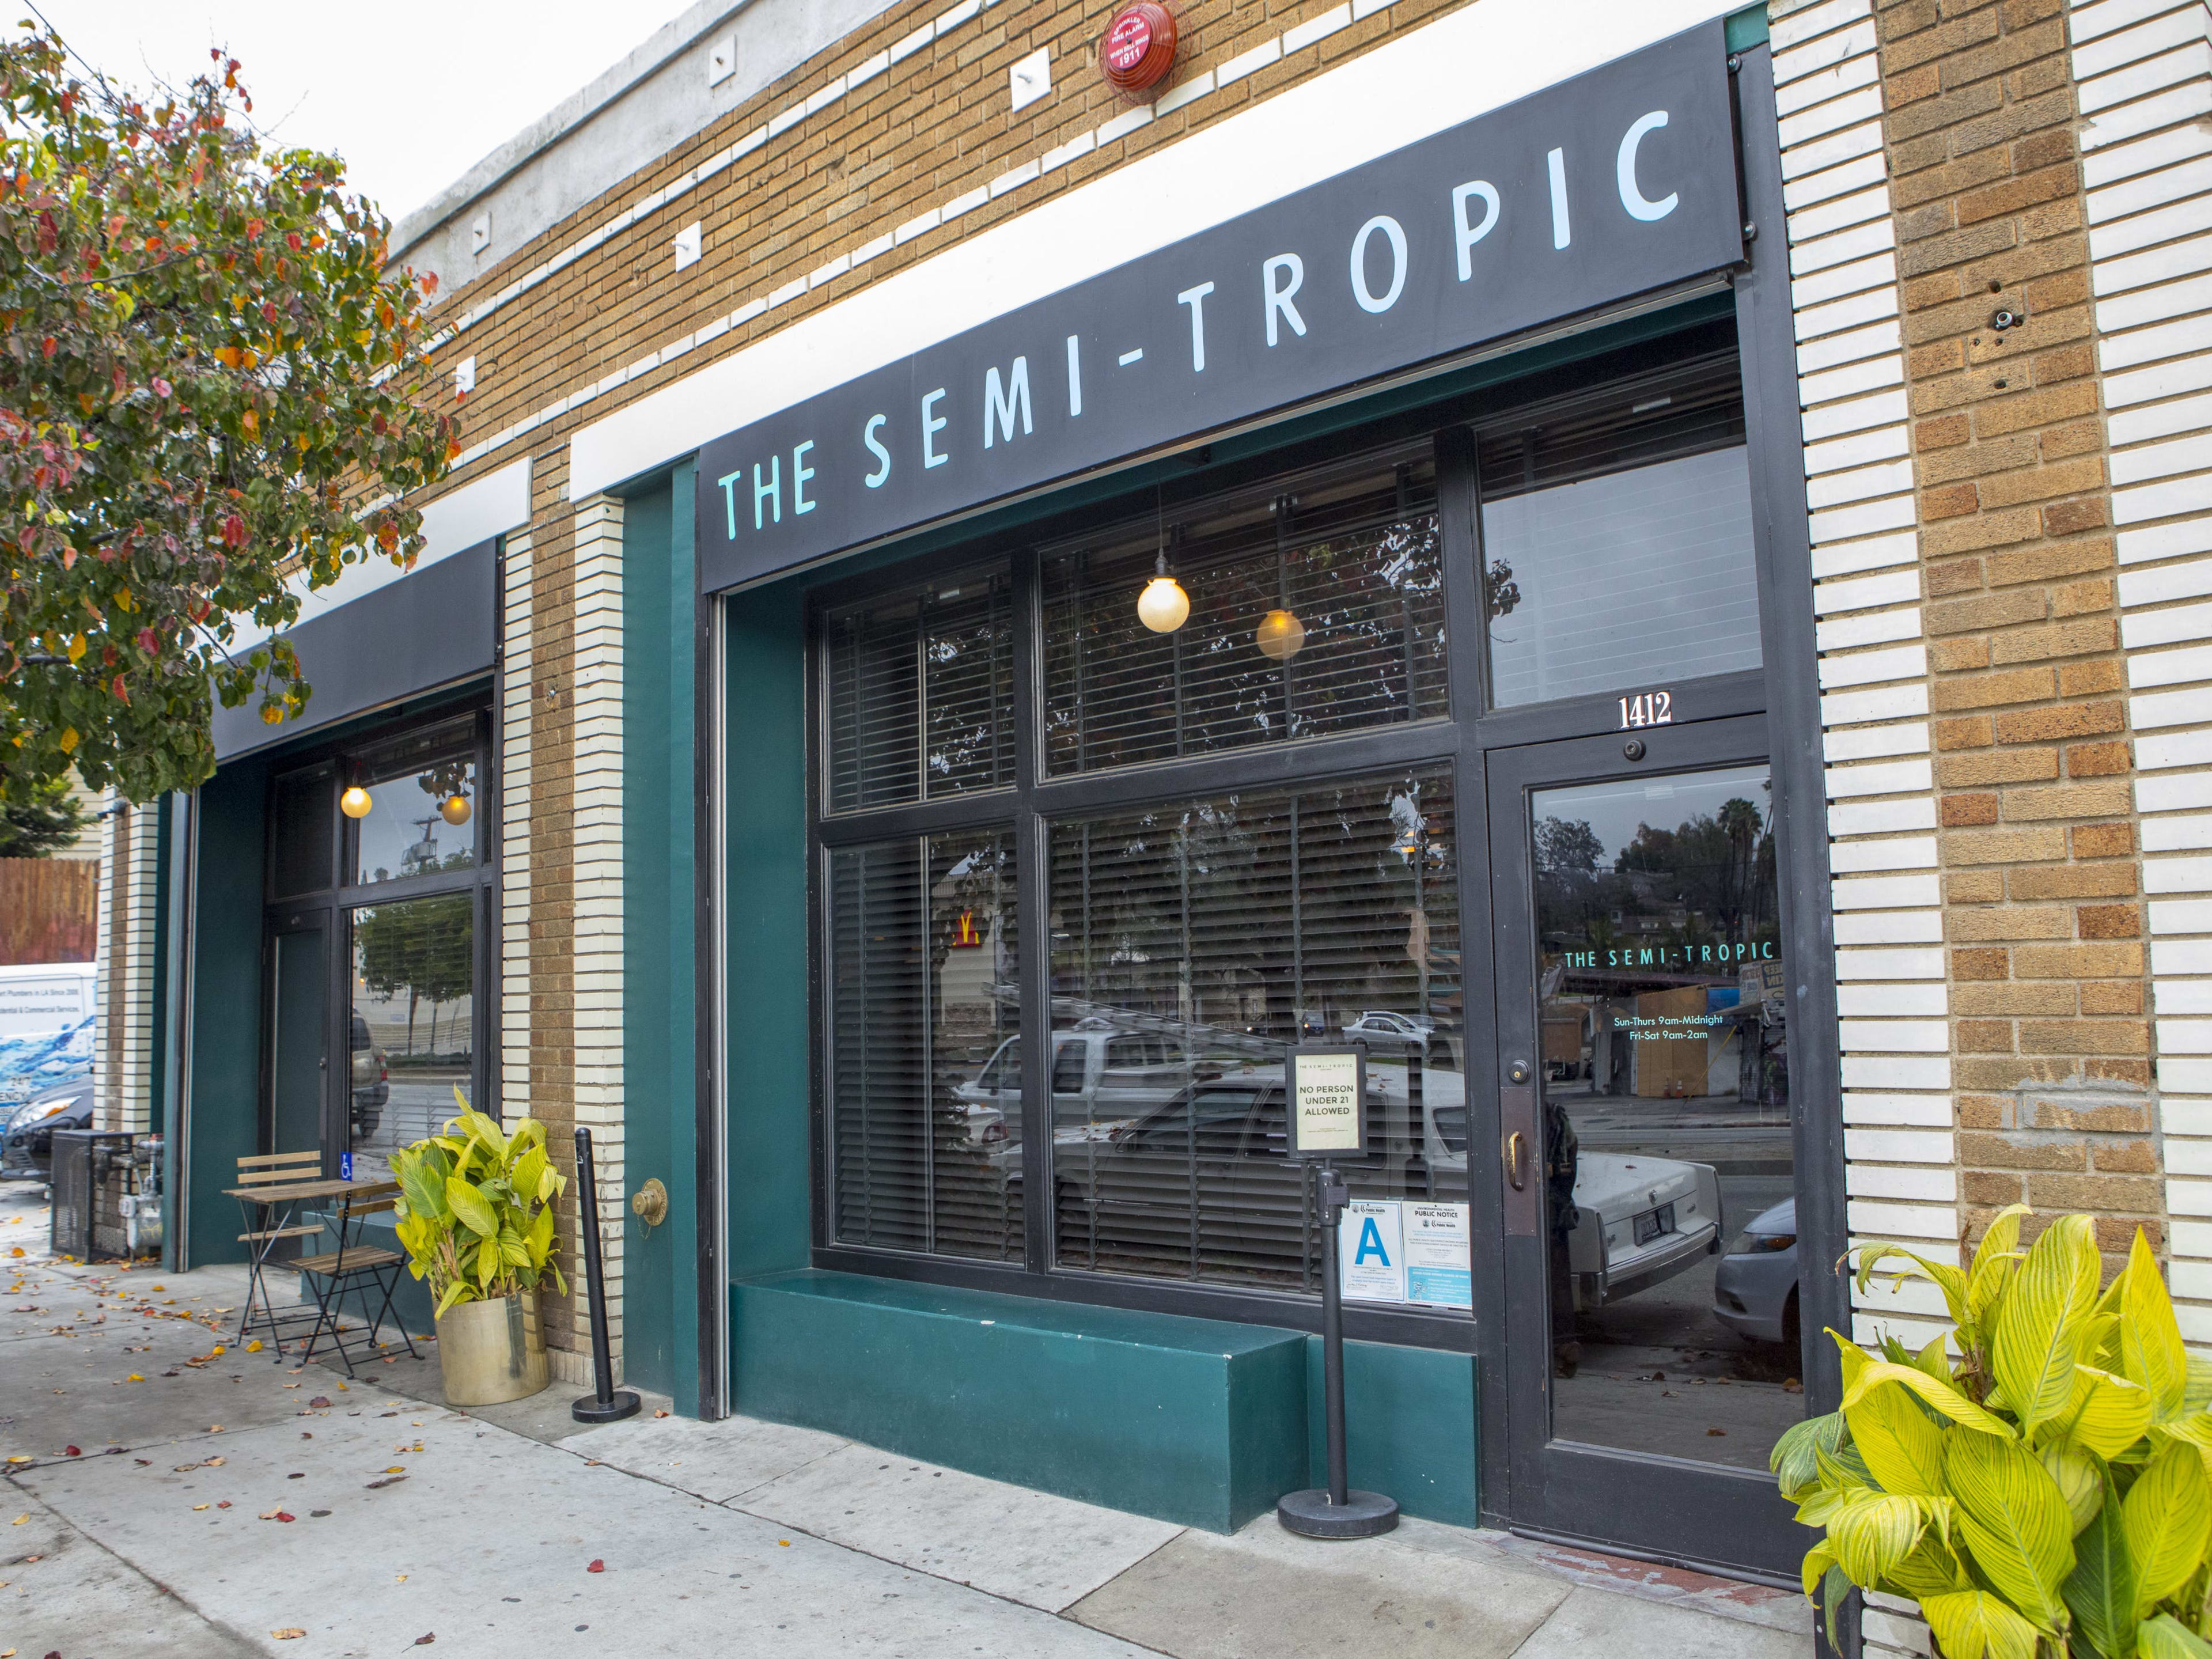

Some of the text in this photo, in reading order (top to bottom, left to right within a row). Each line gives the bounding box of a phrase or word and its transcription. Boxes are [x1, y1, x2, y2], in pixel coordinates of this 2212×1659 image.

[1112, 21, 1144, 44] FIRE ALARM
[1110, 34, 1149, 59] WHEN BELL RINGS
[718, 110, 1679, 540] THE SEMI-TROPIC
[1619, 691, 1672, 729] 1412
[1565, 942, 1774, 968] THE SEMI-TROPIC
[1614, 1015, 1723, 1027] Sun-Thurs 9am-Midnight
[1630, 1030, 1708, 1040] Fri-Sat 9am-2am
[1316, 1085, 1354, 1093] PERSON
[1305, 1107, 1350, 1115] ALLOWED
[1355, 1217, 1391, 1267] A
